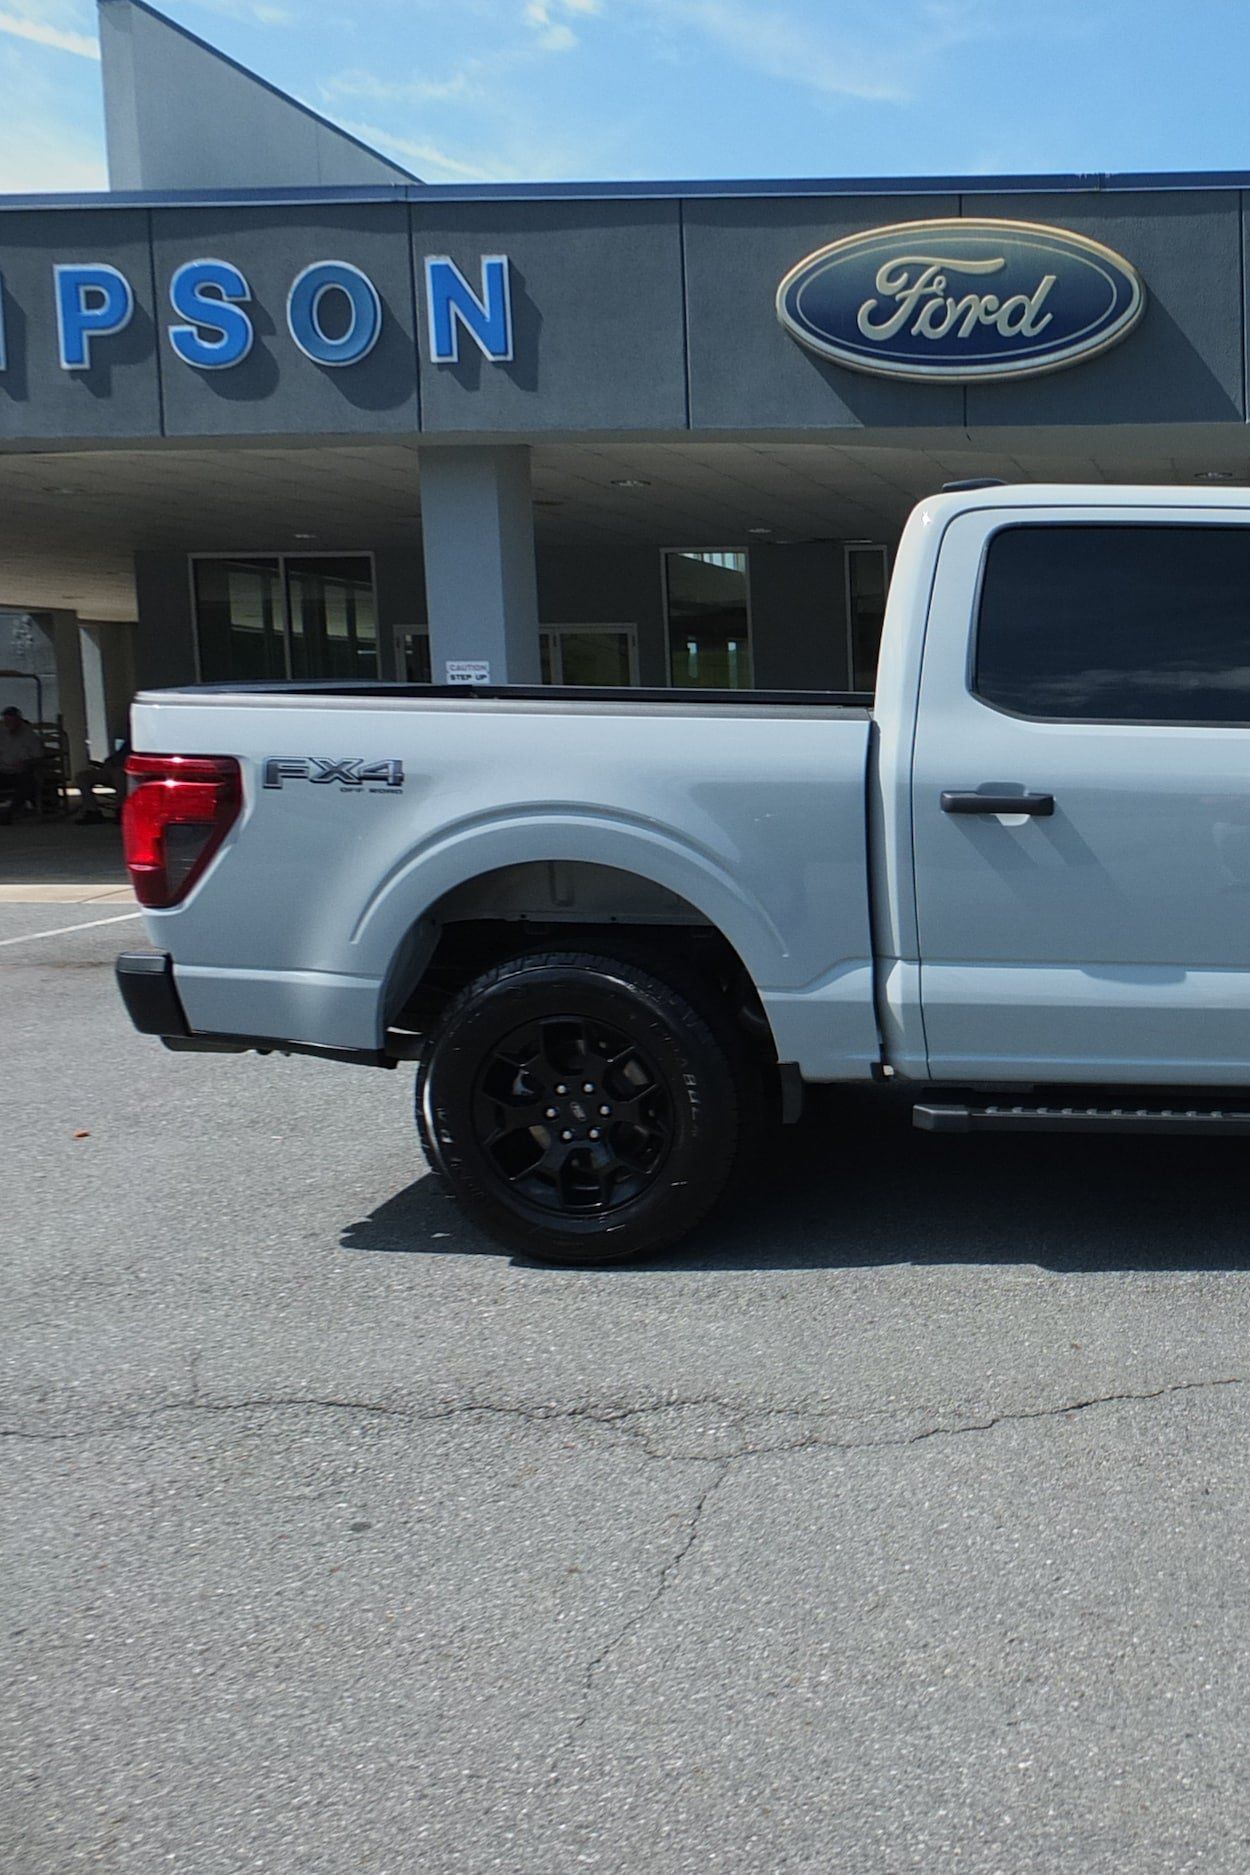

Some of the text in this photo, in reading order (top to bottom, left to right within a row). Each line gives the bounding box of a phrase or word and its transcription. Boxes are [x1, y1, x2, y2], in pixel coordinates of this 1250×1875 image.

[0, 255, 514, 371] PSON
[857, 256, 1057, 341] Ford
[263, 756, 405, 789] FX4
